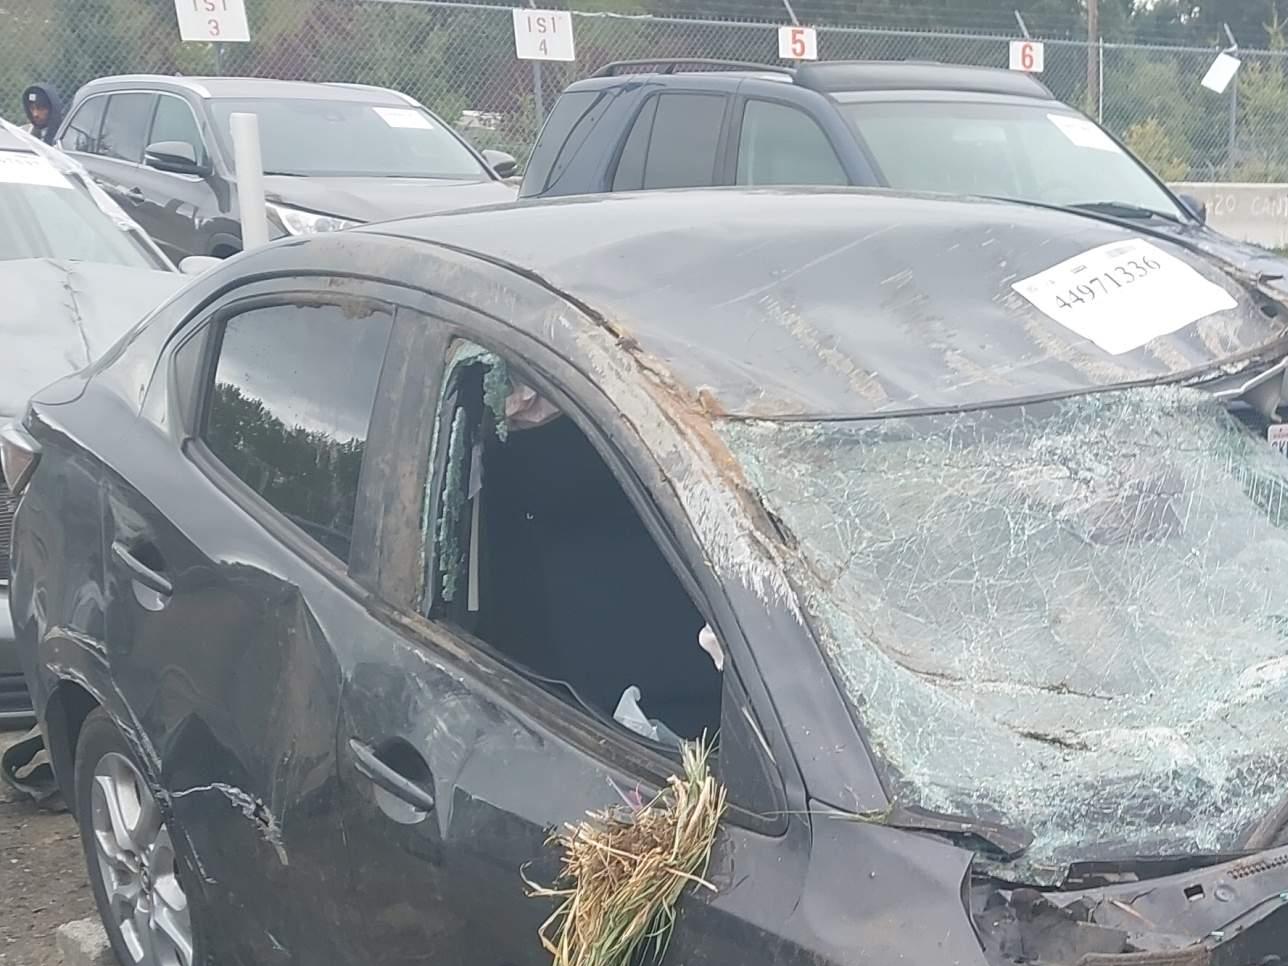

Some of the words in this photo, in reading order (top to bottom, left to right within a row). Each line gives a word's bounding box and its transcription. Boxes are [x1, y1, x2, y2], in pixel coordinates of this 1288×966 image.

[207, 18, 220, 37] 3
[538, 38, 548, 56] 4
[790, 29, 806, 57] 5
[1020, 43, 1034, 69] 6
[1055, 255, 1162, 309] 44971336
